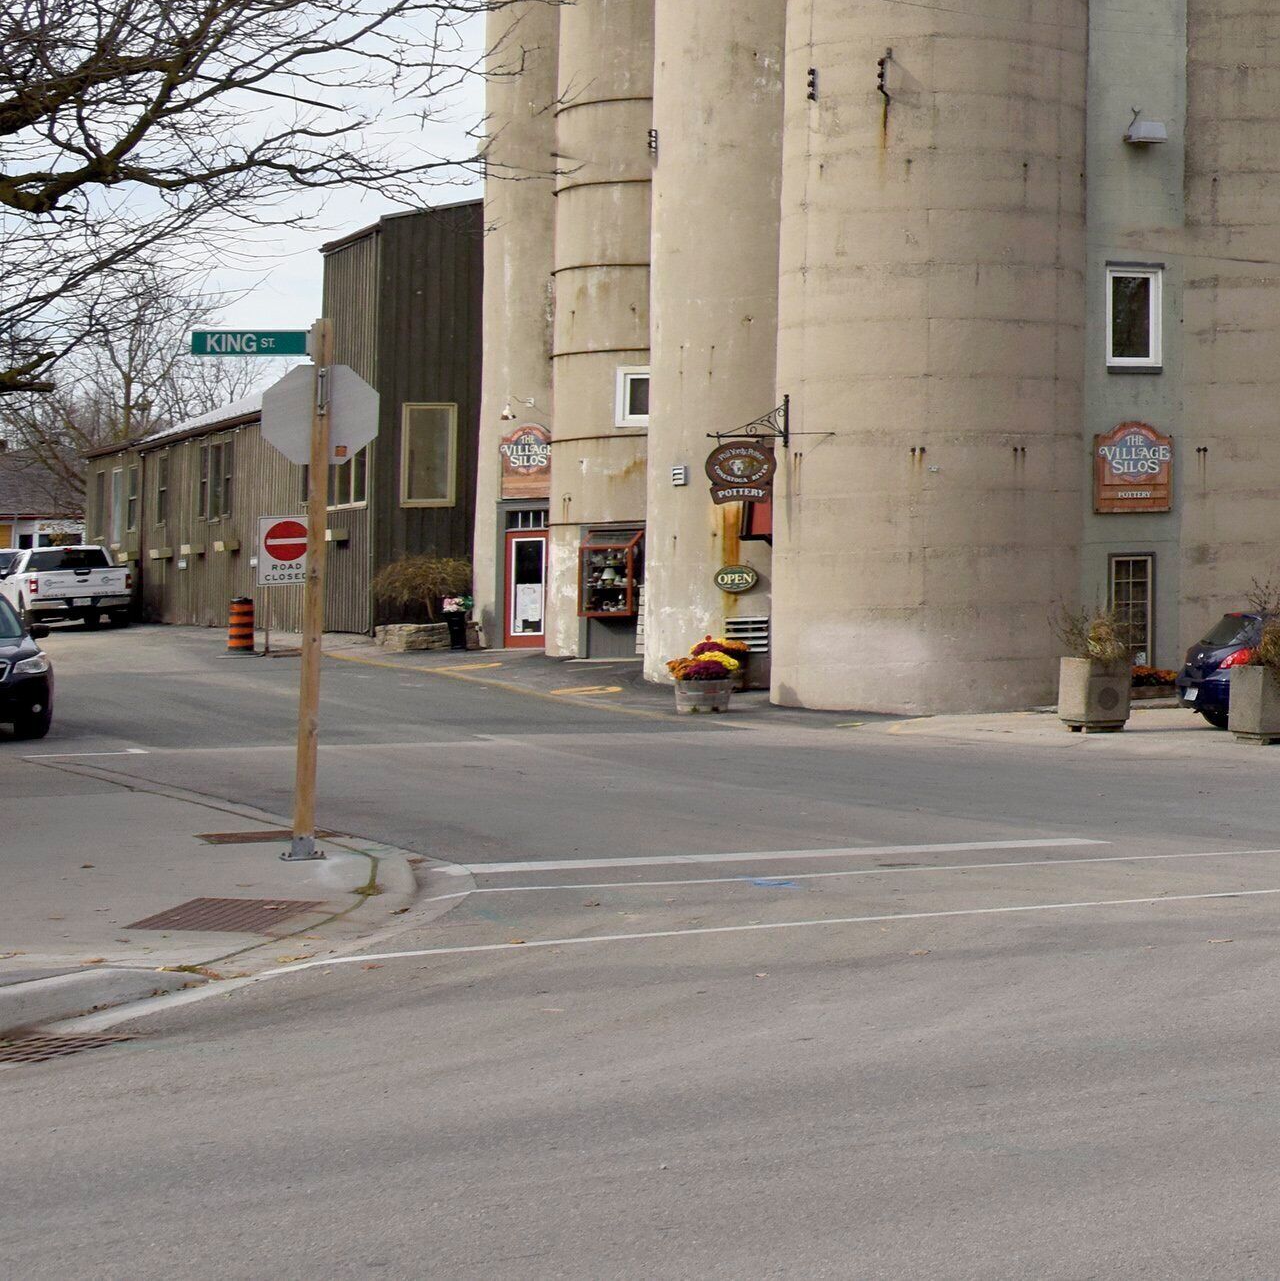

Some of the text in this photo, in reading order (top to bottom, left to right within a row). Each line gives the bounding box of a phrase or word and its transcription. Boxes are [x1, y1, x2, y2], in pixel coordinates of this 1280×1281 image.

[206, 333, 275, 352] KING ST.
[520, 434, 535, 444] THE
[1125, 434, 1144, 446] THE
[1099, 445, 1170, 460] VILLAGE
[510, 454, 547, 467] SILOS
[1112, 459, 1160, 473] SILOS
[751, 464, 769, 481] RIVER
[717, 487, 766, 498] POTTERY
[272, 563, 302, 571] ROAD
[717, 573, 753, 585] OPEN
